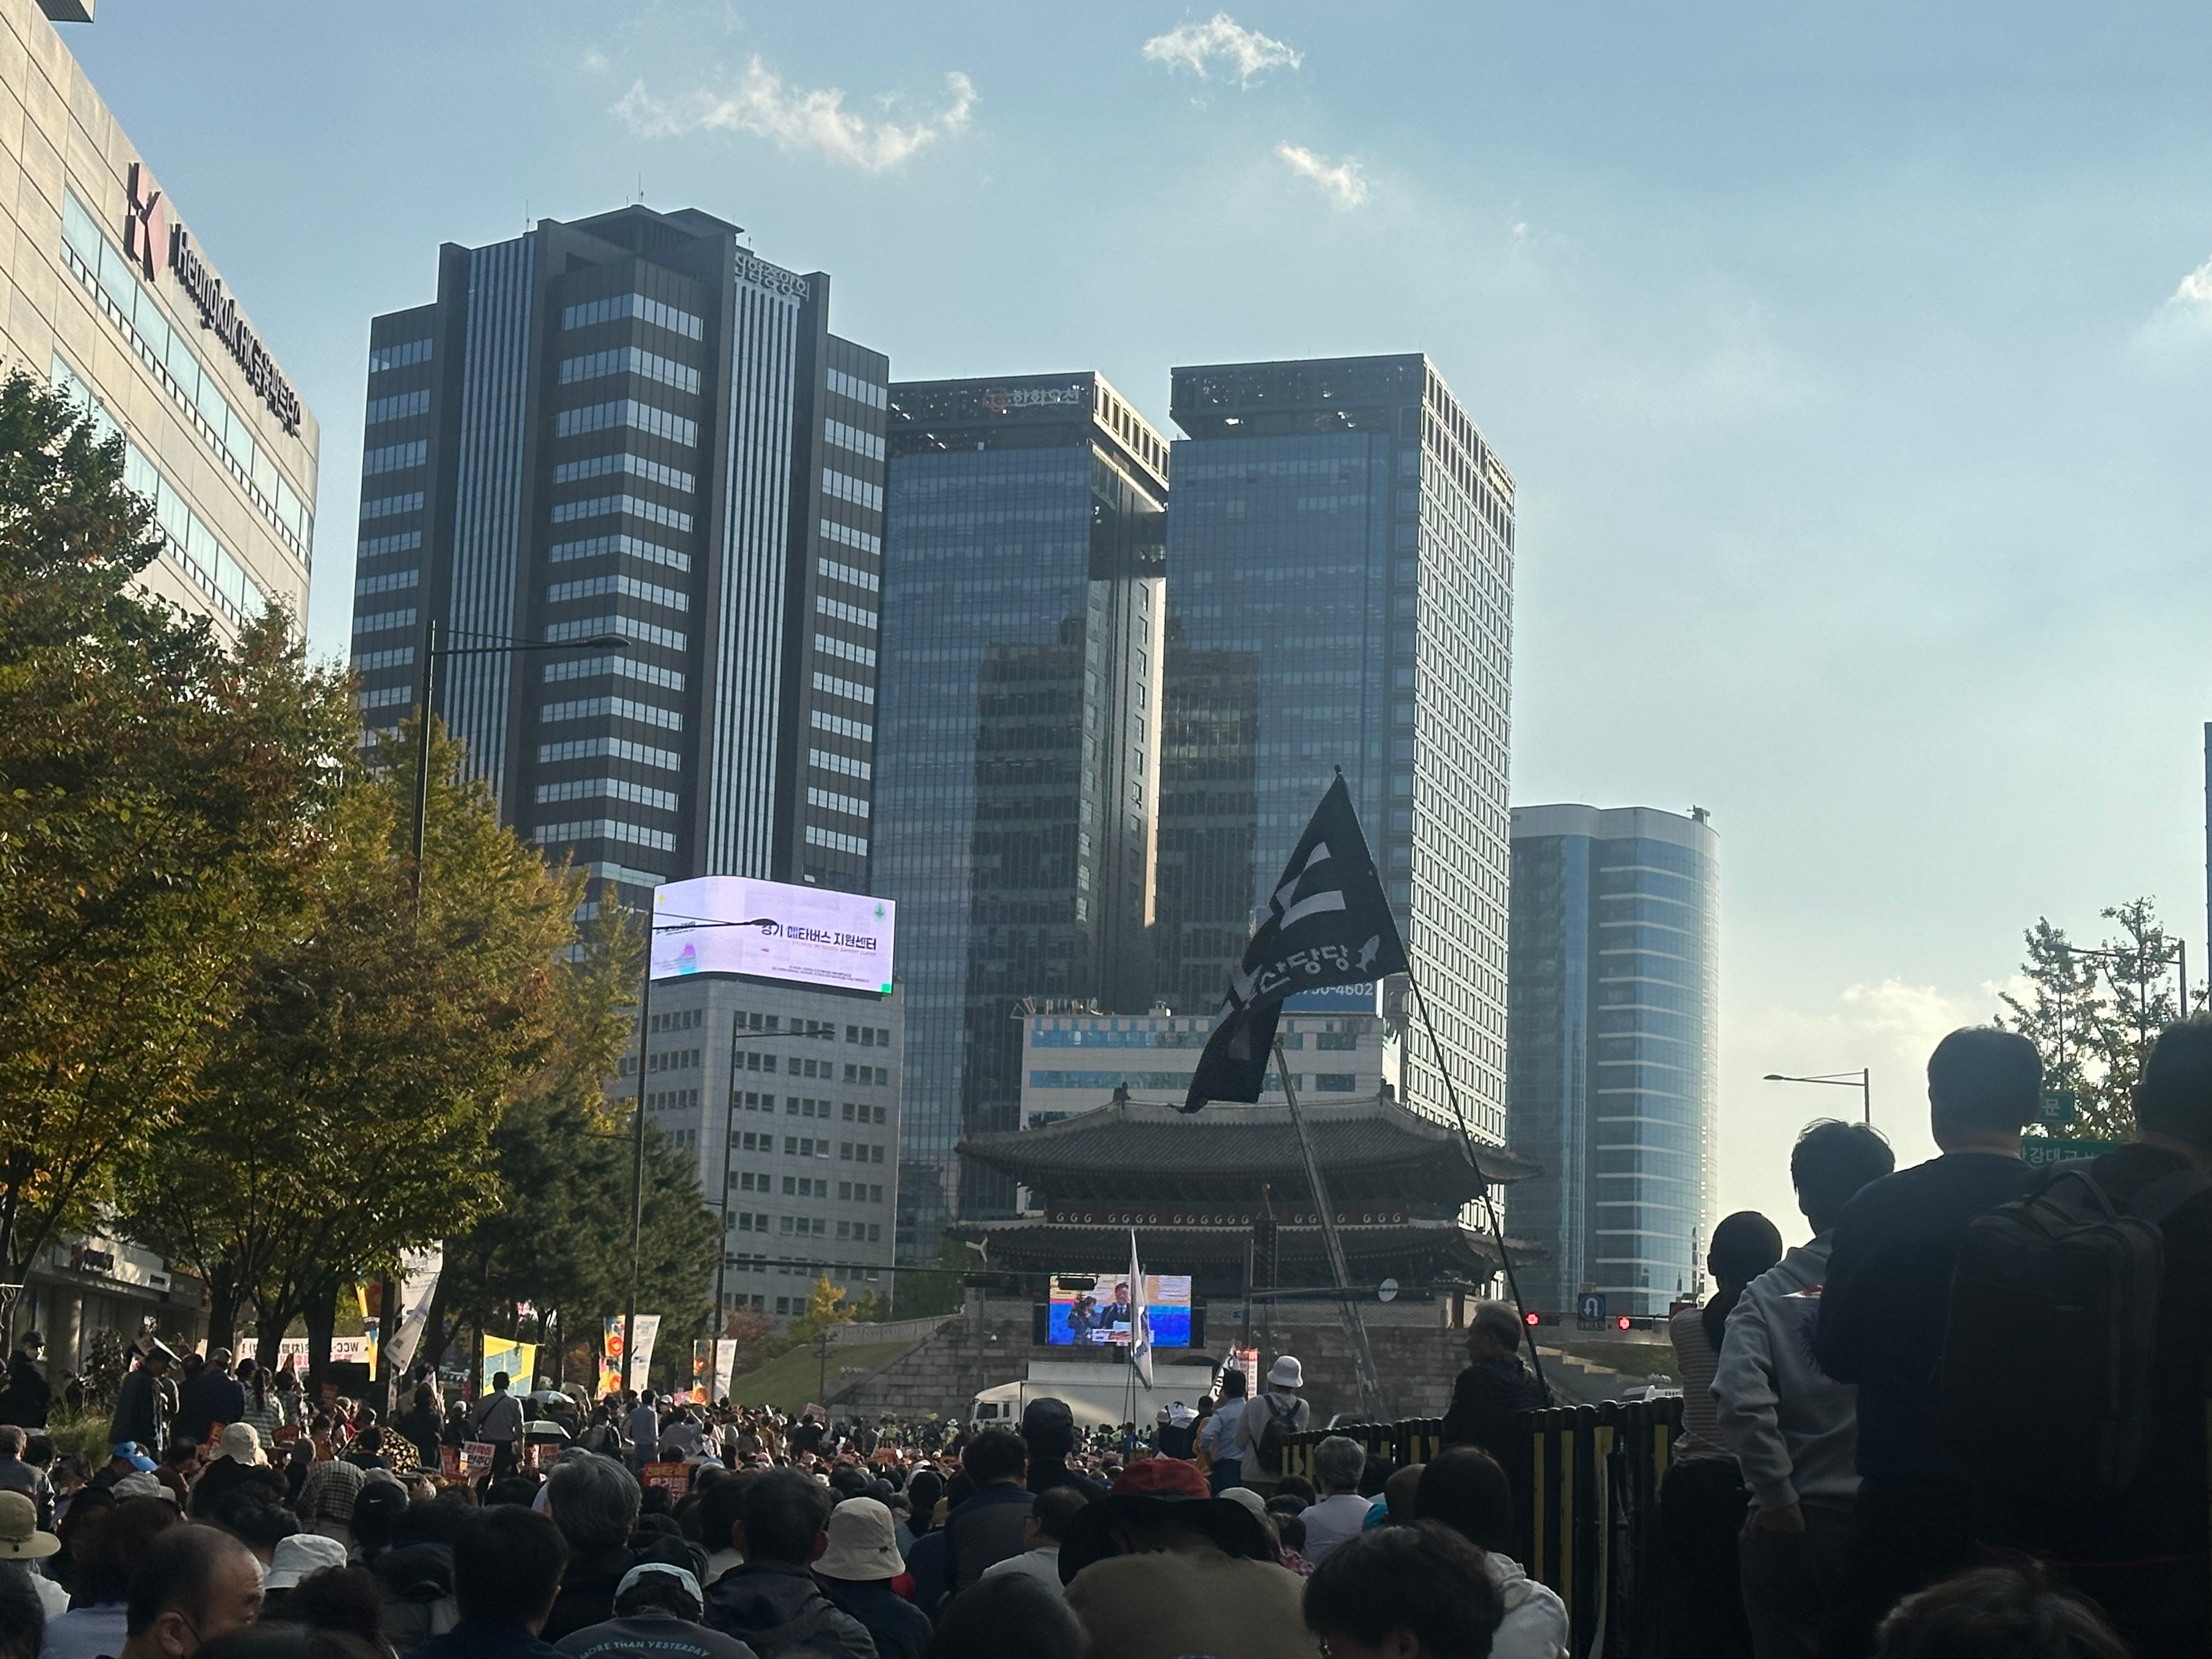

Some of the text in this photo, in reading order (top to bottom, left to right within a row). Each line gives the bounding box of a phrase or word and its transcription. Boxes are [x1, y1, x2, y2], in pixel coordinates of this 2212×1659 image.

[177, 229, 239, 350] Heungkuk
[735, 251, 810, 302] 신협중앙회
[787, 926, 832, 944] 메타버스
[833, 932, 877, 951] 지원센터
[579, 1640, 711, 1659] MORE THAN YESTERDAY
